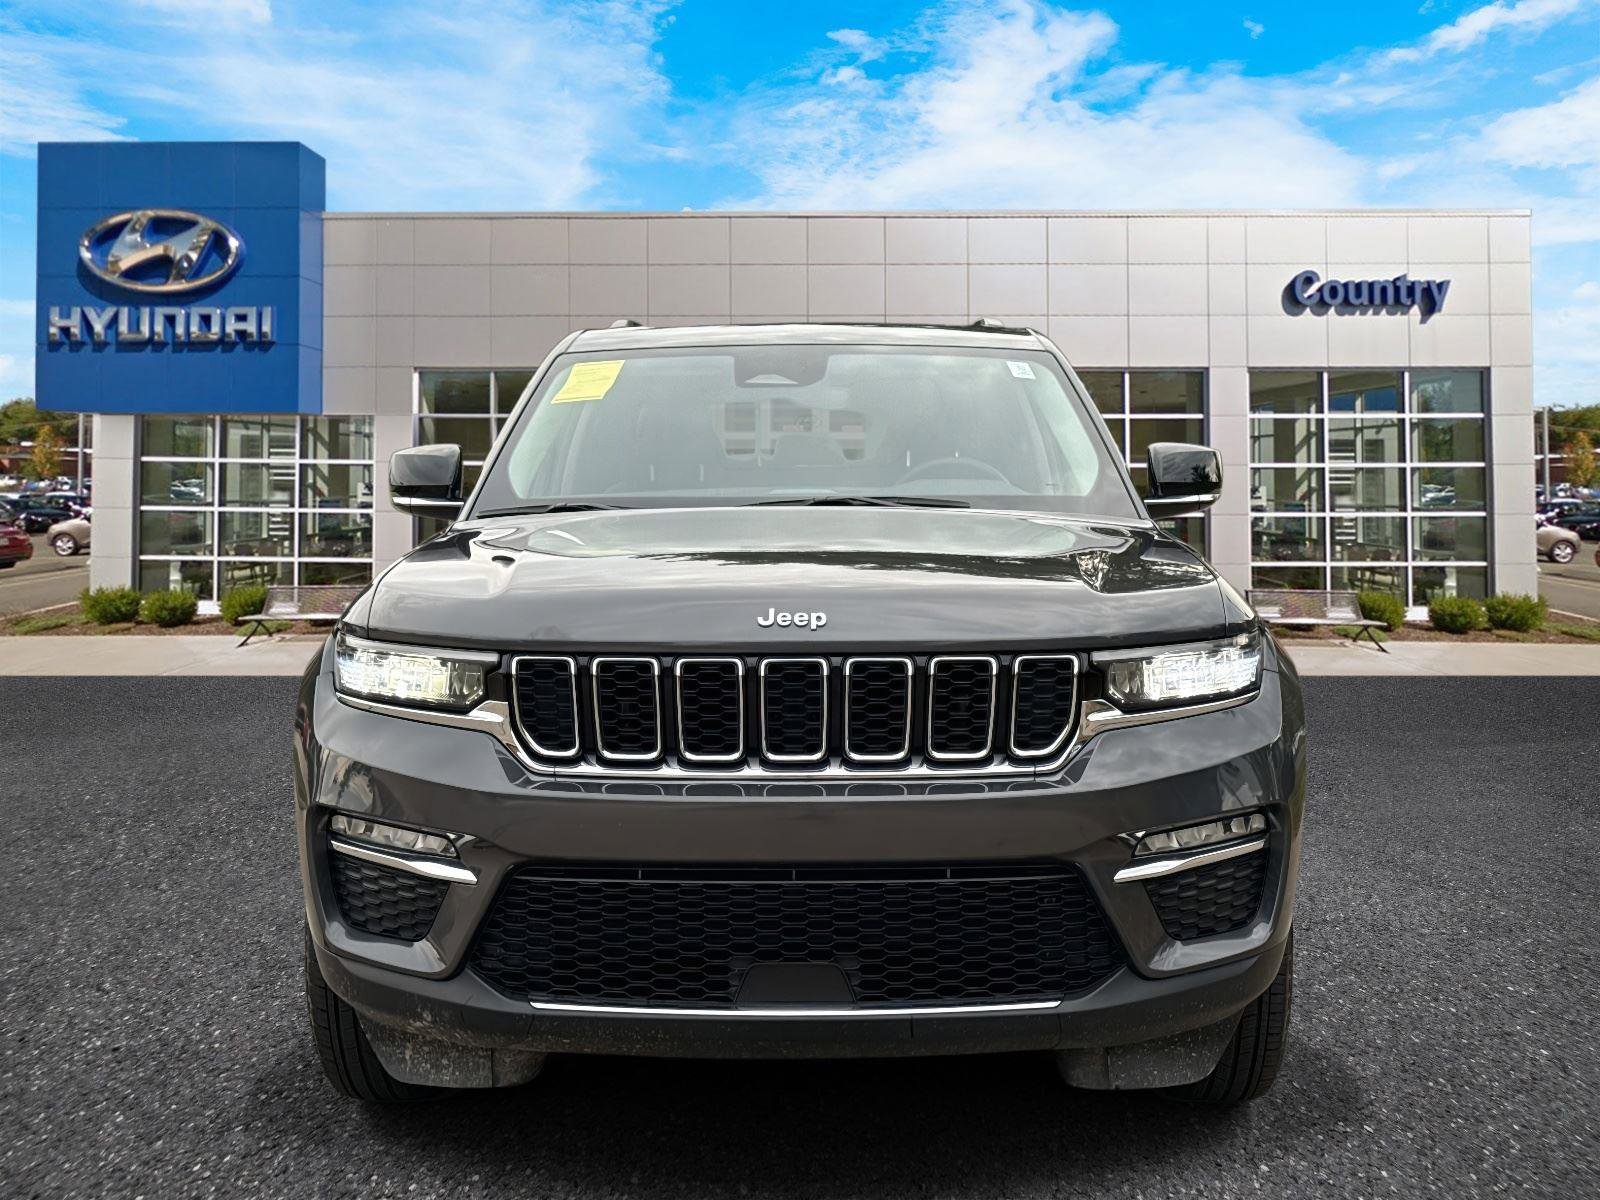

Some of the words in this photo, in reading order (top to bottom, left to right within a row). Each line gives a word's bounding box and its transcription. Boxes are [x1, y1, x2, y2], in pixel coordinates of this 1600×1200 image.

[1291, 269, 1451, 314] Country
[49, 306, 273, 342] HYUNDAI
[757, 607, 827, 631] Jeep
